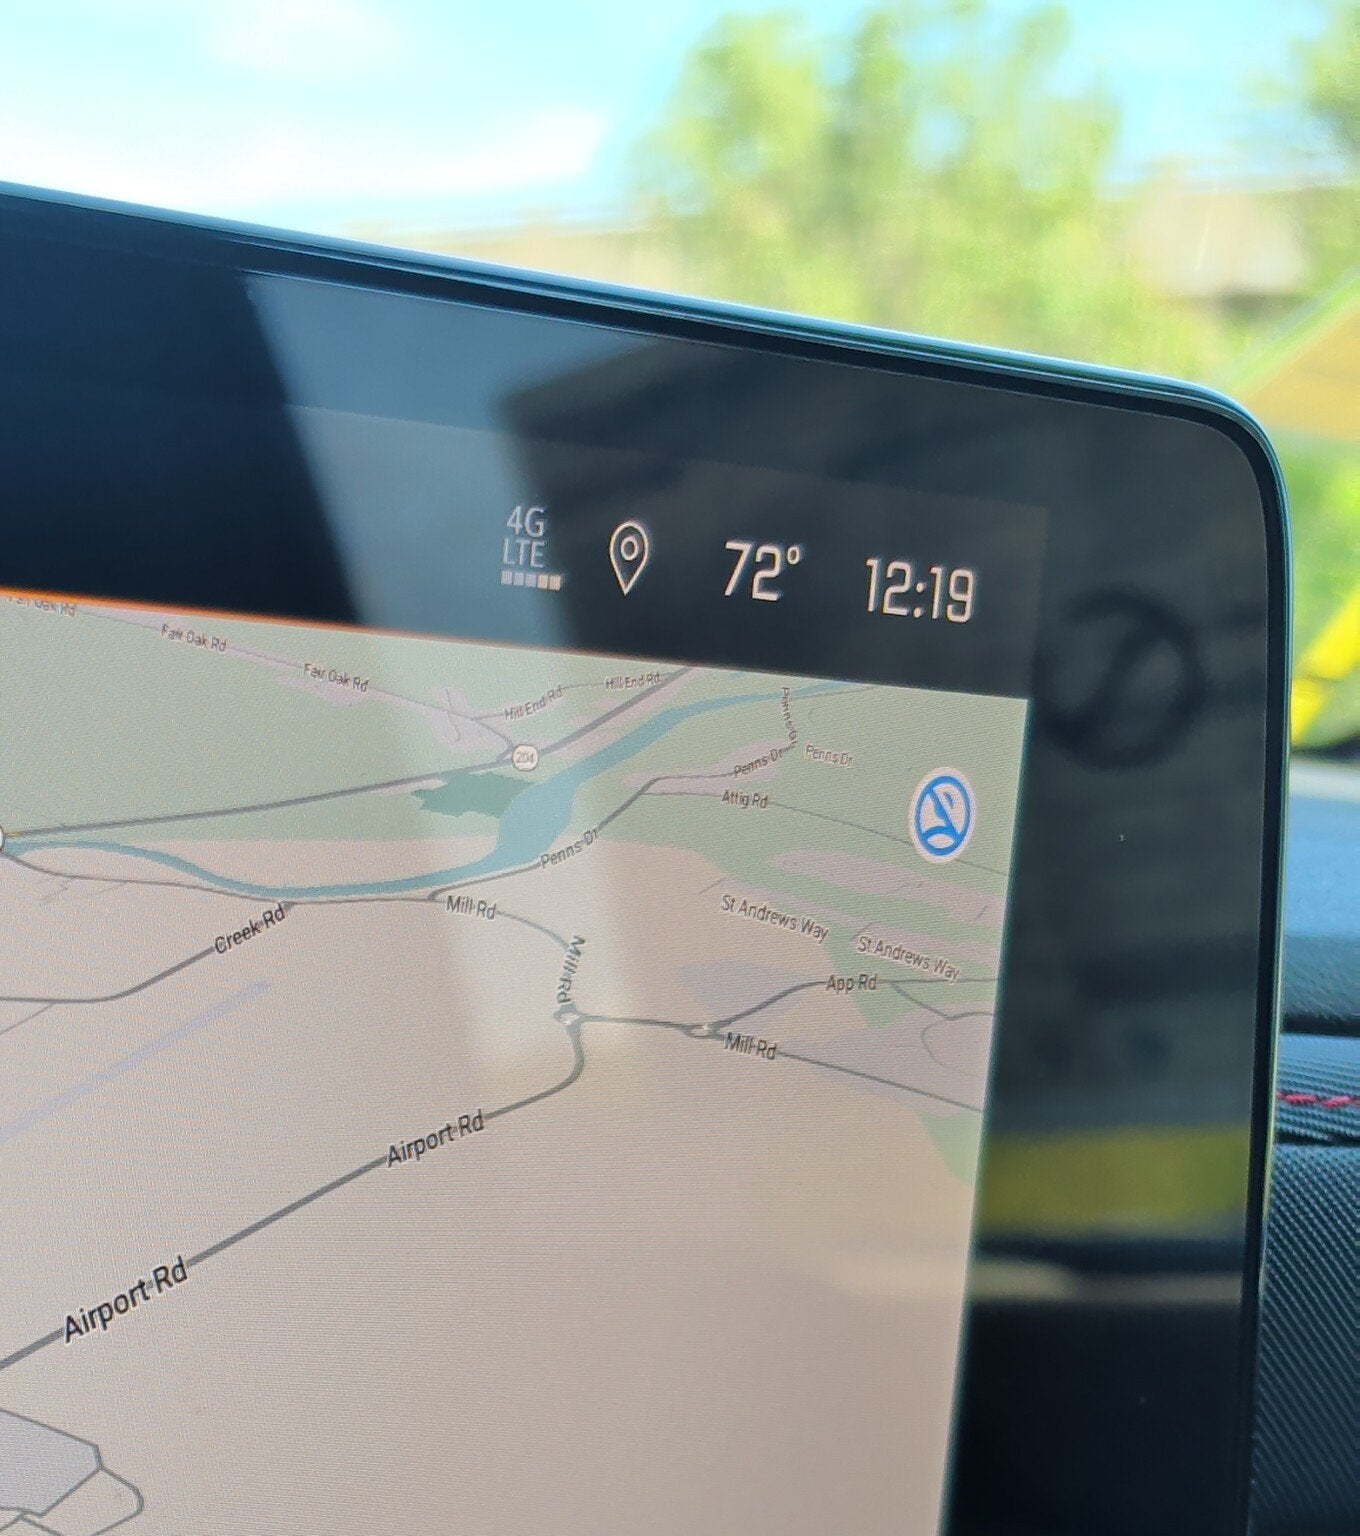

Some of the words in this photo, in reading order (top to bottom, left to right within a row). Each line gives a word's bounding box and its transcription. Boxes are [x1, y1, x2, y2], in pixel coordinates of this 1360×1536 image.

[506, 505, 545, 537] 4G
[502, 538, 546, 569] LTE
[724, 540, 802, 602] 72°
[865, 557, 975, 623] 12:19
[161, 624, 183, 640] Fair
[187, 630, 208, 647] Oak
[211, 635, 227, 652] Rd
[303, 663, 325, 680] Fair
[328, 669, 351, 686] Oak
[353, 676, 370, 693] Rd
[606, 677, 622, 689] Hill
[624, 675, 643, 688] End
[645, 671, 662, 686] Rd
[505, 701, 522, 721] Hill
[524, 693, 544, 714] End
[543, 685, 564, 704] Rd
[515, 752, 535, 765] 204
[734, 755, 769, 778] Penns
[769, 747, 784, 763] Dr
[806, 744, 839, 764] Penns
[840, 752, 854, 767] Dr
[721, 789, 750, 808] Attig
[753, 791, 769, 809] Rd
[540, 840, 582, 870] Penns
[583, 827, 599, 847] Dr
[446, 895, 473, 915] Mill
[476, 899, 496, 920] Rd
[721, 895, 735, 912] St
[737, 900, 797, 931] Andrews
[800, 917, 829, 944] Way
[215, 919, 262, 954] Creek
[262, 902, 285, 928] Rd
[562, 935, 586, 974] Mill
[857, 935, 872, 953] St
[874, 940, 930, 971] Andrews
[932, 958, 960, 983] Way
[557, 976, 571, 1004] Rd
[826, 975, 854, 994] App
[858, 974, 878, 990] Rd
[724, 1032, 754, 1053] Mill
[757, 1039, 777, 1060] Rd
[387, 1122, 454, 1168] Airport
[457, 1109, 484, 1137] Rd
[66, 1279, 150, 1343] Airport
[153, 1255, 187, 1293] Rd
